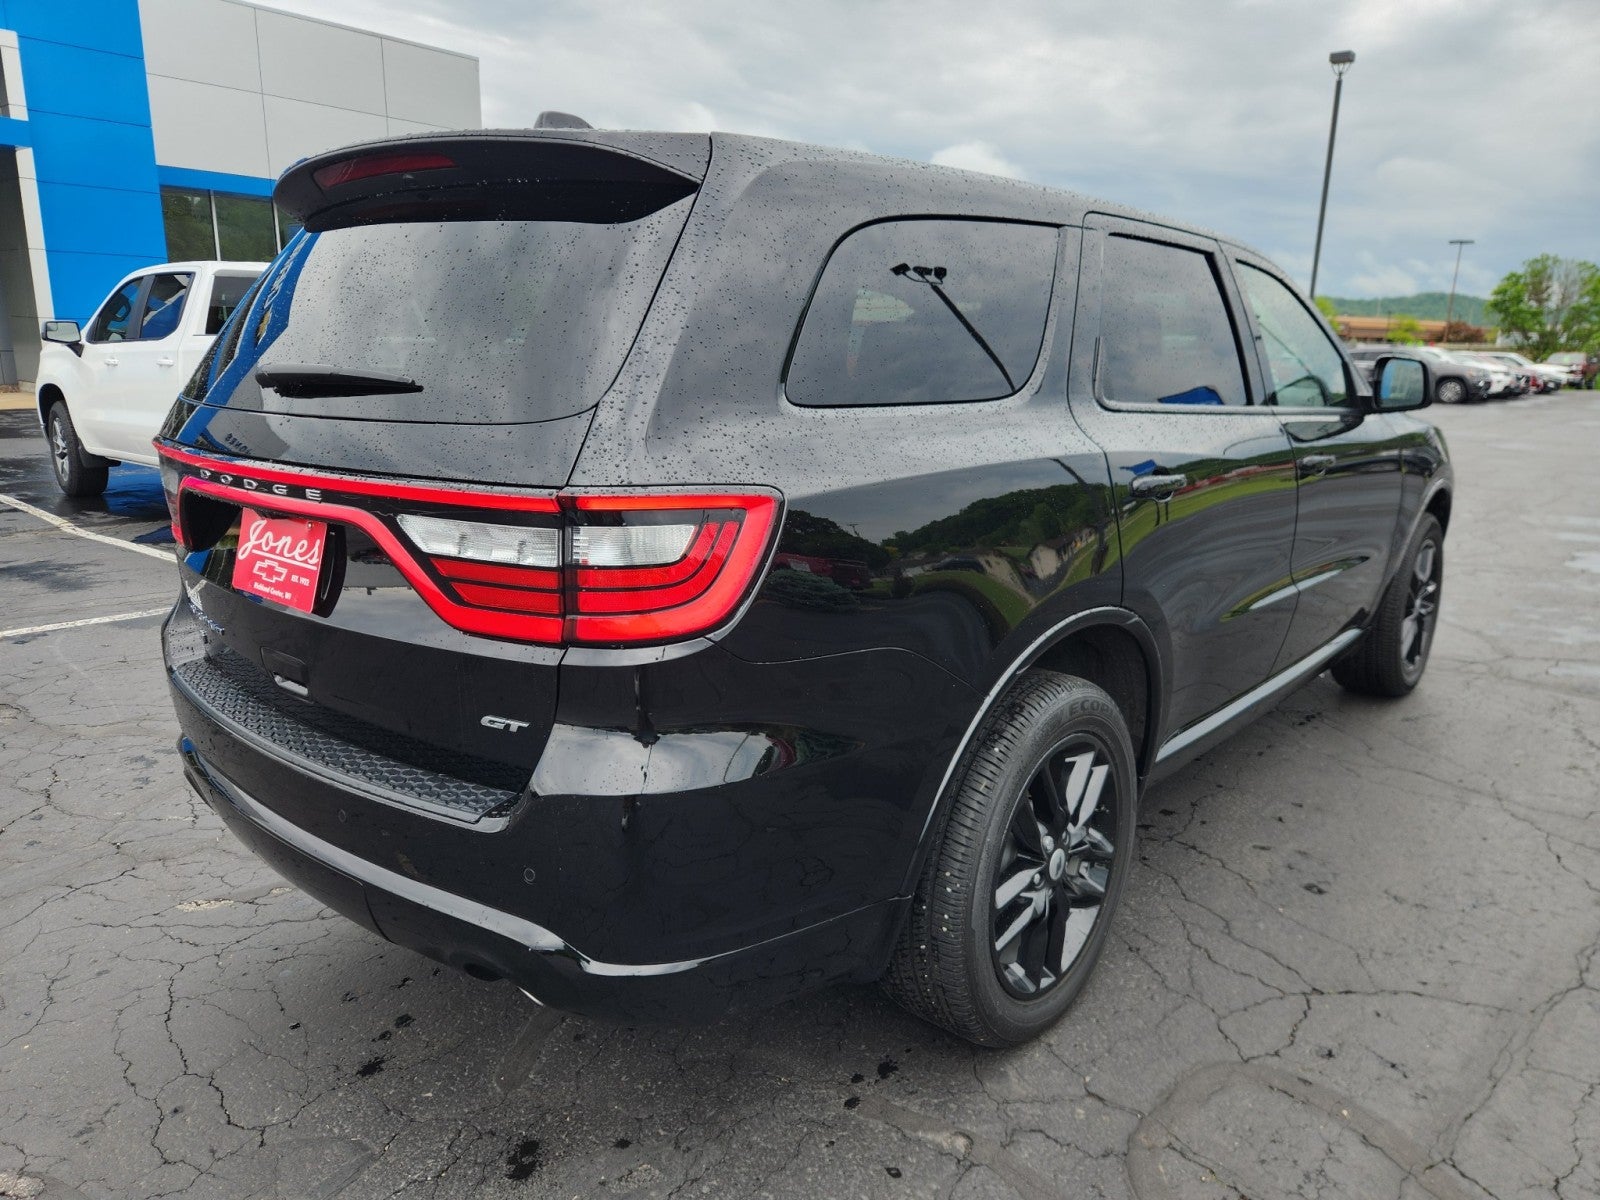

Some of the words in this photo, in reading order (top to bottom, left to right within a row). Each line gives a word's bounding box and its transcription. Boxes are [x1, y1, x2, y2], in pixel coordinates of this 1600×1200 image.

[200, 469, 322, 501] DODGE
[238, 519, 320, 564] Jones
[480, 715, 530, 733] GT
